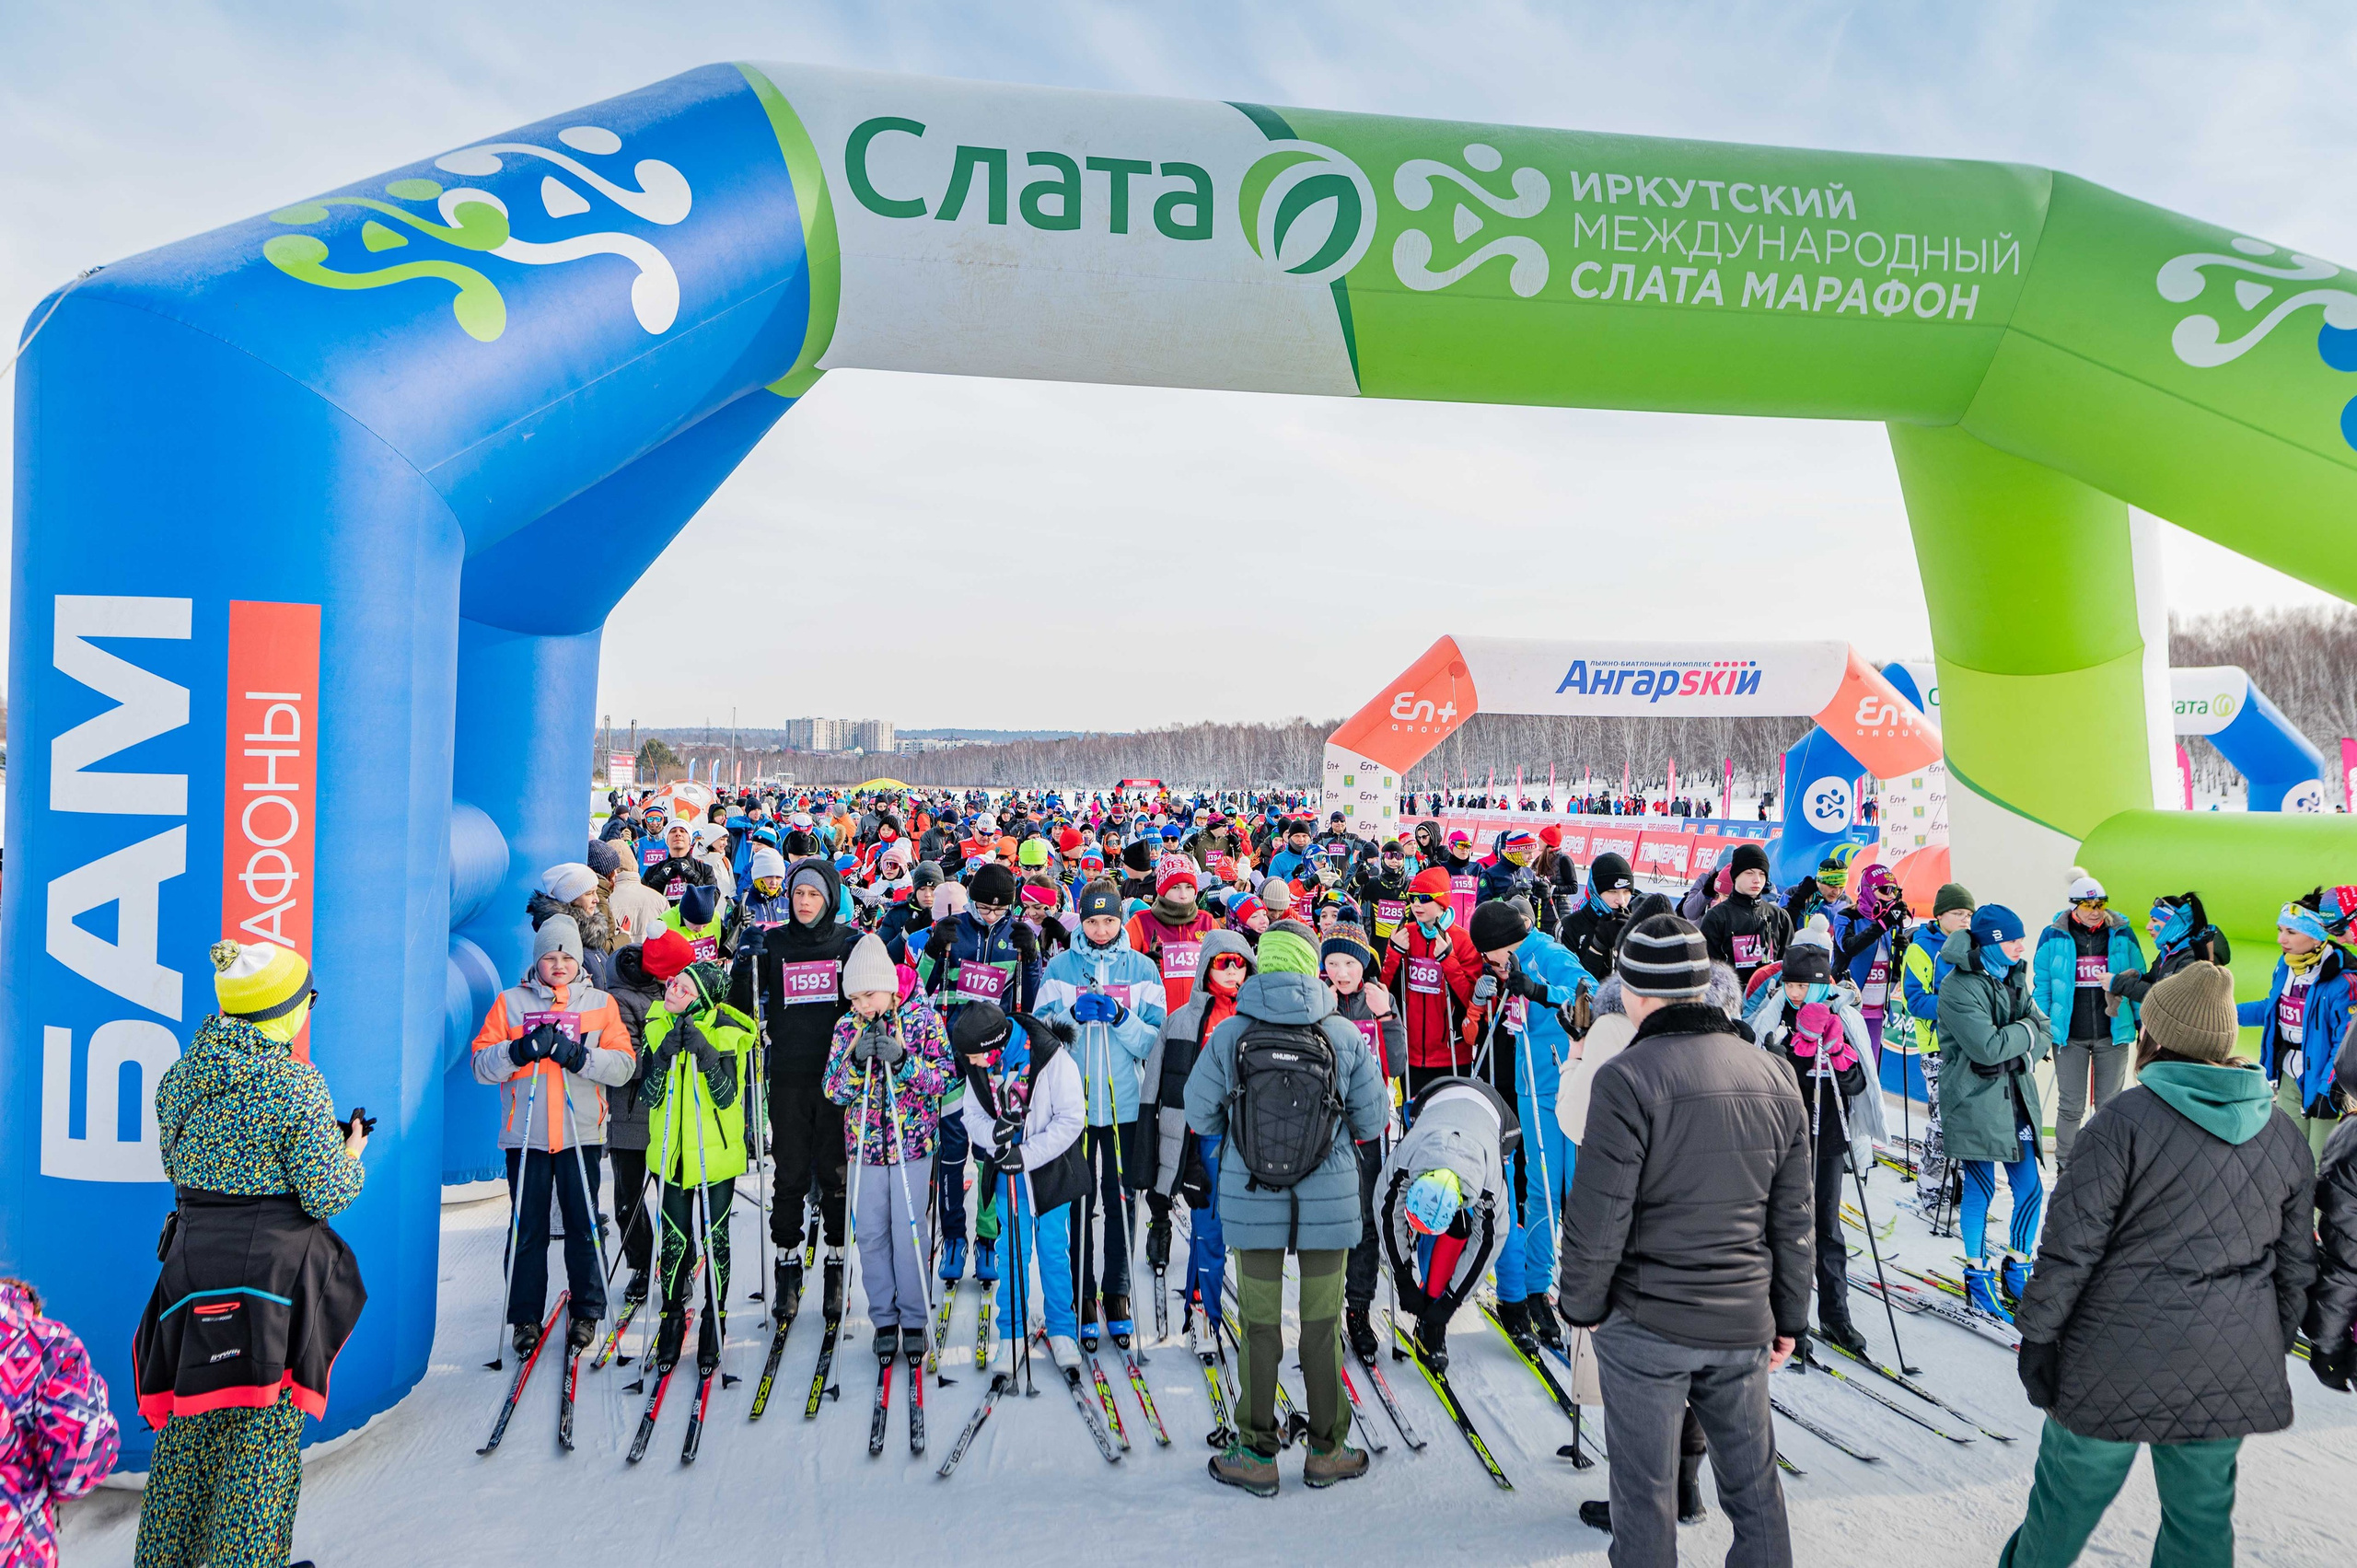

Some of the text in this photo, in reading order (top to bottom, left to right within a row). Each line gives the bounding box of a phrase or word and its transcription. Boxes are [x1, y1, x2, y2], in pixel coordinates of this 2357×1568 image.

[844, 116, 1213, 241] Слата
[1570, 170, 1857, 221] ИРКУТСКИЙ
[1573, 213, 2021, 276] МЕЖДУНАРОДНЫЙ
[1570, 261, 1980, 320] СЛАТА МАРАФОН
[2172, 700, 2208, 714] ата
[1391, 724, 1451, 733] GROUP
[1856, 728, 1922, 737] GROUP
[239, 691, 302, 947] АФОНЫ
[646, 854, 664, 862] 1373
[40, 594, 192, 1183] БАМ
[668, 882, 686, 893] 138
[1380, 906, 1403, 917] 1285
[694, 944, 716, 960] 562
[789, 972, 831, 992] 1593
[965, 972, 999, 993] 1176
[1408, 965, 1438, 982] 1268
[2279, 1003, 2301, 1022] 1131
[1831, 1343, 1857, 1361] NORDWAY
[751, 1376, 772, 1414] FISCHER
